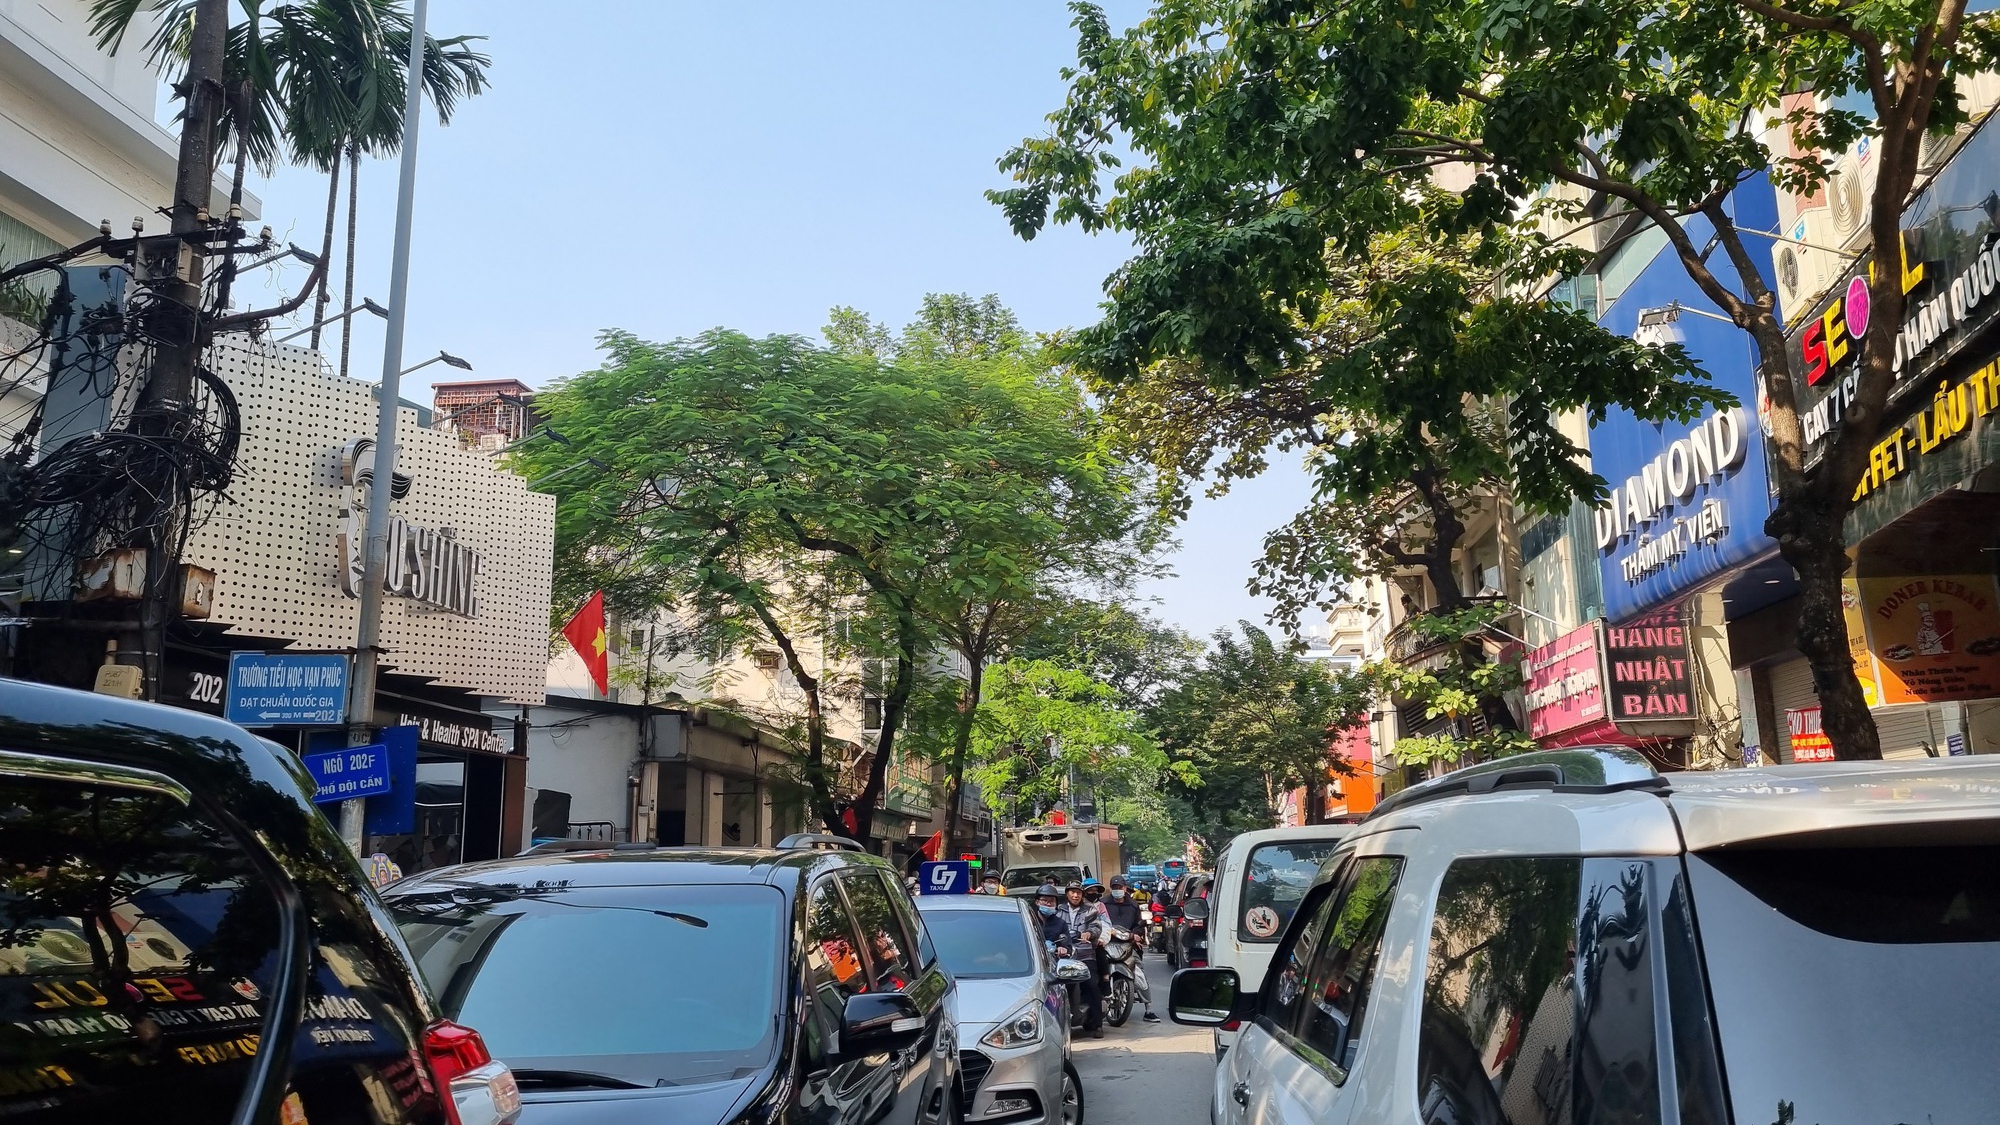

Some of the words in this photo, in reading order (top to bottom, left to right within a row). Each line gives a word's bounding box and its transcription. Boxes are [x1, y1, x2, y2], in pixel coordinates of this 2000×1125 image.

[1803, 230, 1924, 387] SEOL
[1904, 291, 1949, 361] HÀN
[1803, 396, 1829, 445] CAY
[1830, 386, 1840, 423] 7
[1918, 379, 1968, 455] LẨU
[1594, 406, 1743, 551] DIAMOND
[1620, 534, 1659, 582] THẨM
[1686, 498, 1725, 545] VIỆN
[1877, 580, 1929, 620] DONER
[237, 661, 268, 688] TRƯỜNG
[269, 659, 286, 688] TIỂU
[286, 666, 302, 691] HỌC
[303, 666, 319, 691] VẠN
[320, 662, 342, 688] PHÚC
[1615, 655, 1686, 686] NHẬT
[190, 672, 223, 704] 202
[240, 697, 258, 711] ĐẠT
[260, 692, 290, 708] CHUẨN
[292, 693, 317, 708] QUỐC
[319, 697, 334, 708] GIA
[1623, 687, 1689, 716] BẢN
[314, 709, 335, 722] 202
[421, 718, 429, 740] &
[431, 720, 460, 746] Health
[462, 726, 480, 749] SPA
[481, 731, 508, 754] Center
[323, 754, 343, 775] NGÕ
[350, 753, 376, 772] 202F
[338, 778, 357, 793] ĐỘI
[359, 774, 383, 790] CẤN
[931, 865, 957, 891] G7
